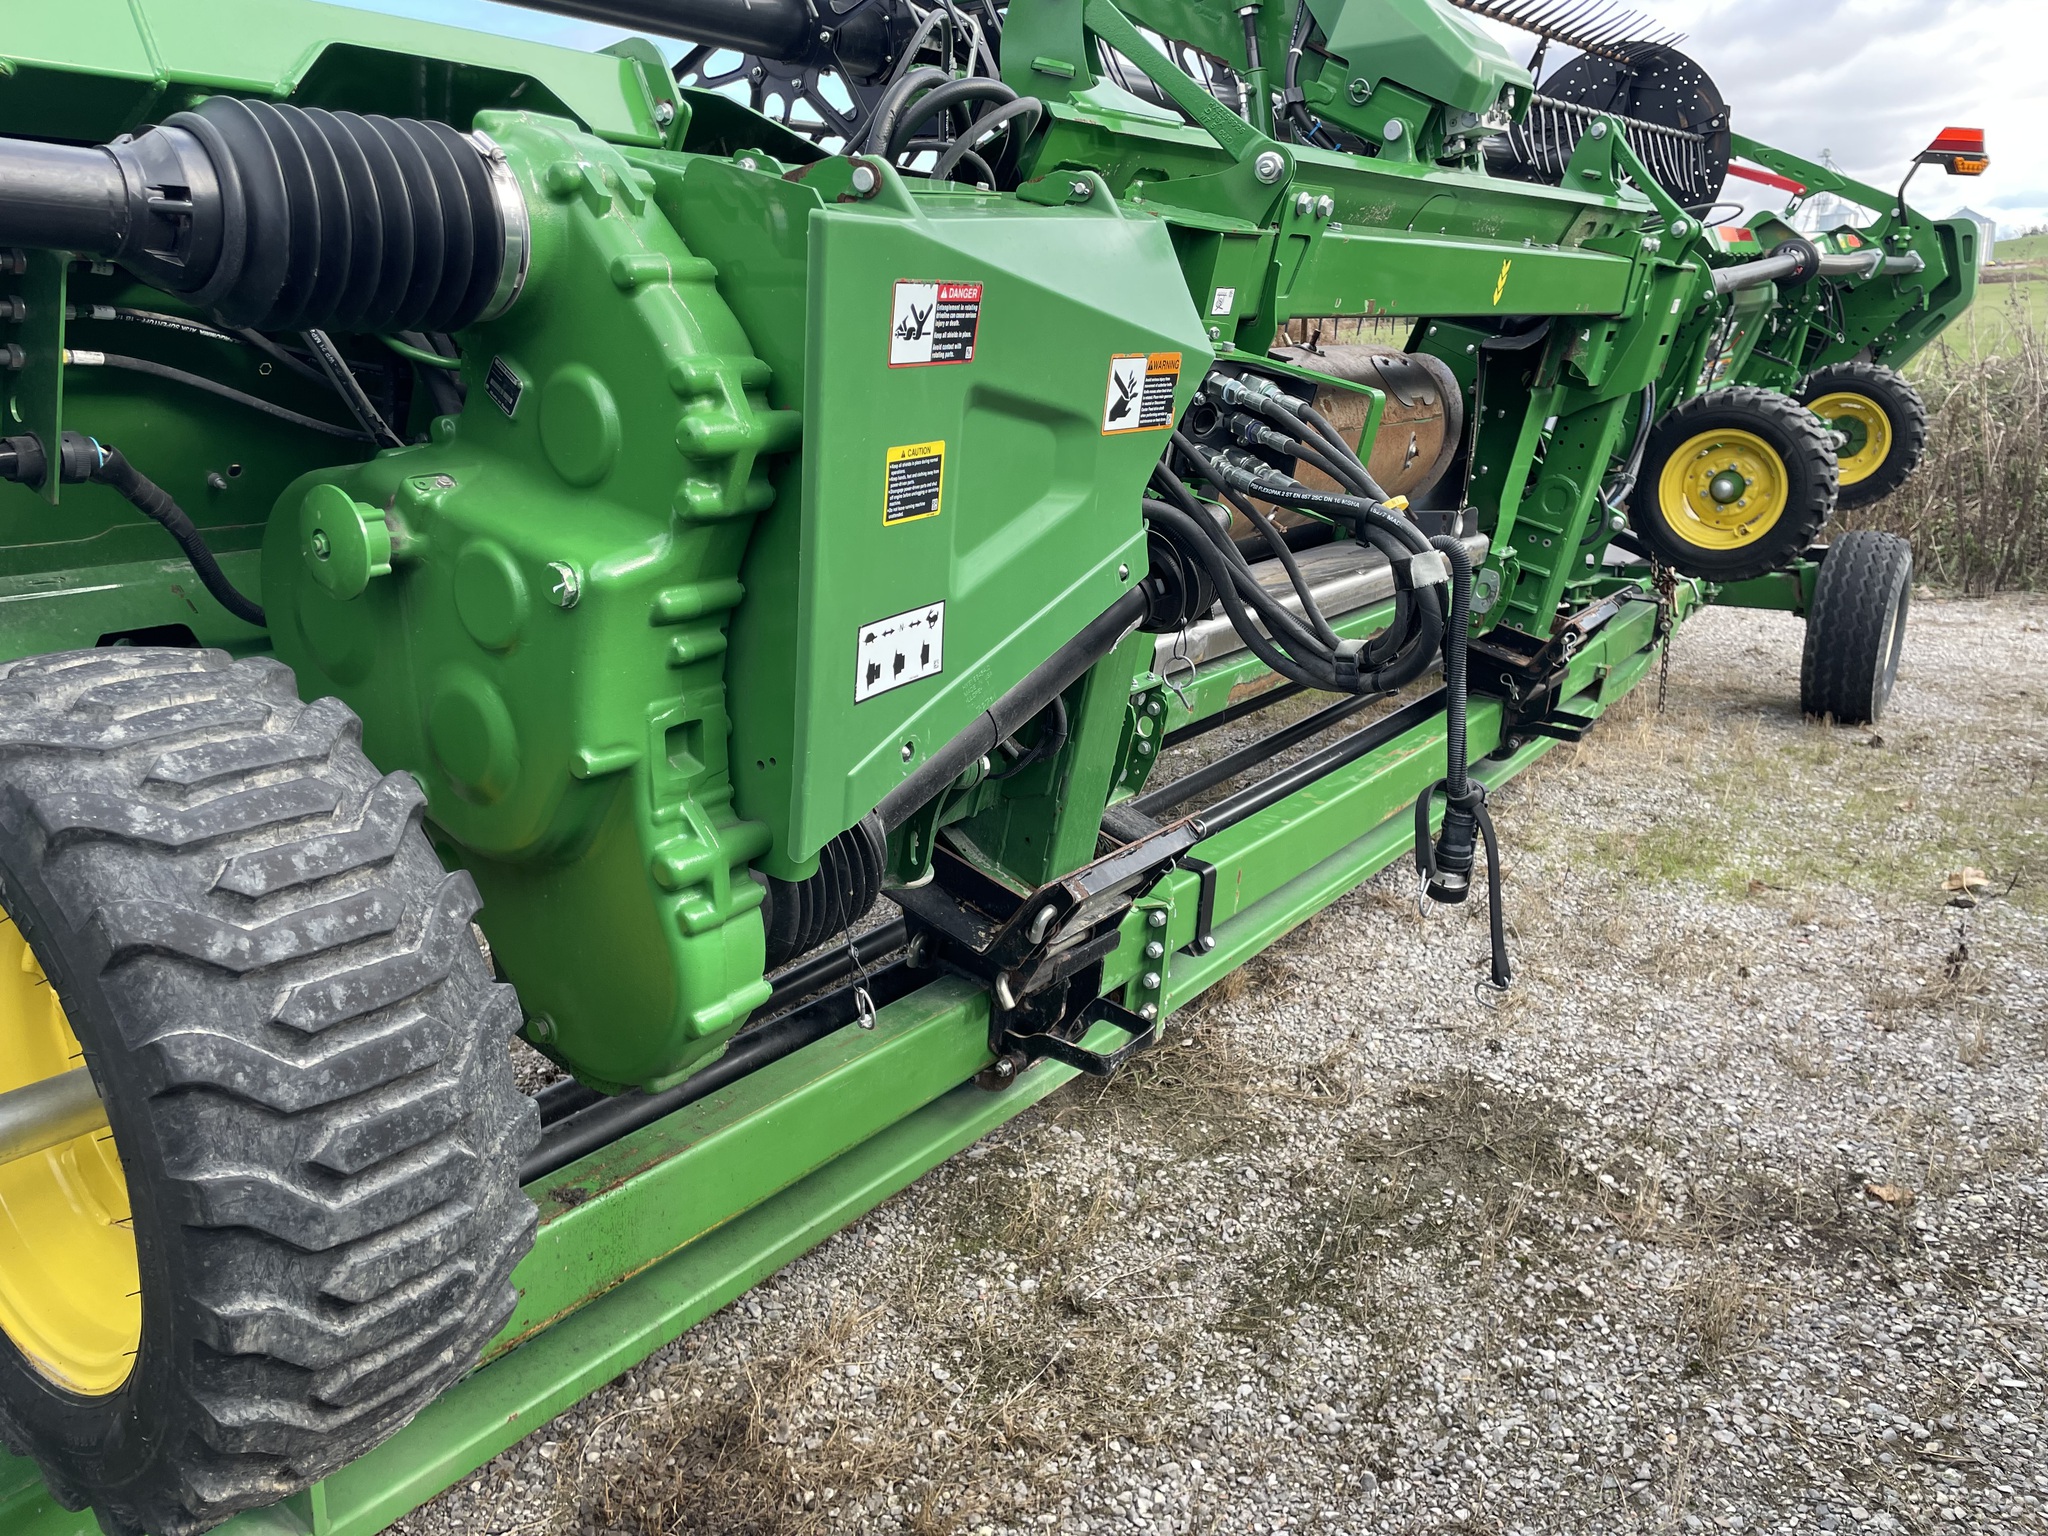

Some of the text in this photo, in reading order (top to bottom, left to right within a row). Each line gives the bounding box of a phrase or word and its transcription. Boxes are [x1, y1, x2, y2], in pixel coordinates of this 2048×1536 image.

[949, 288, 977, 298] DANGER
[1153, 360, 1179, 370] WARNING
[908, 446, 931, 457] CAUTION
